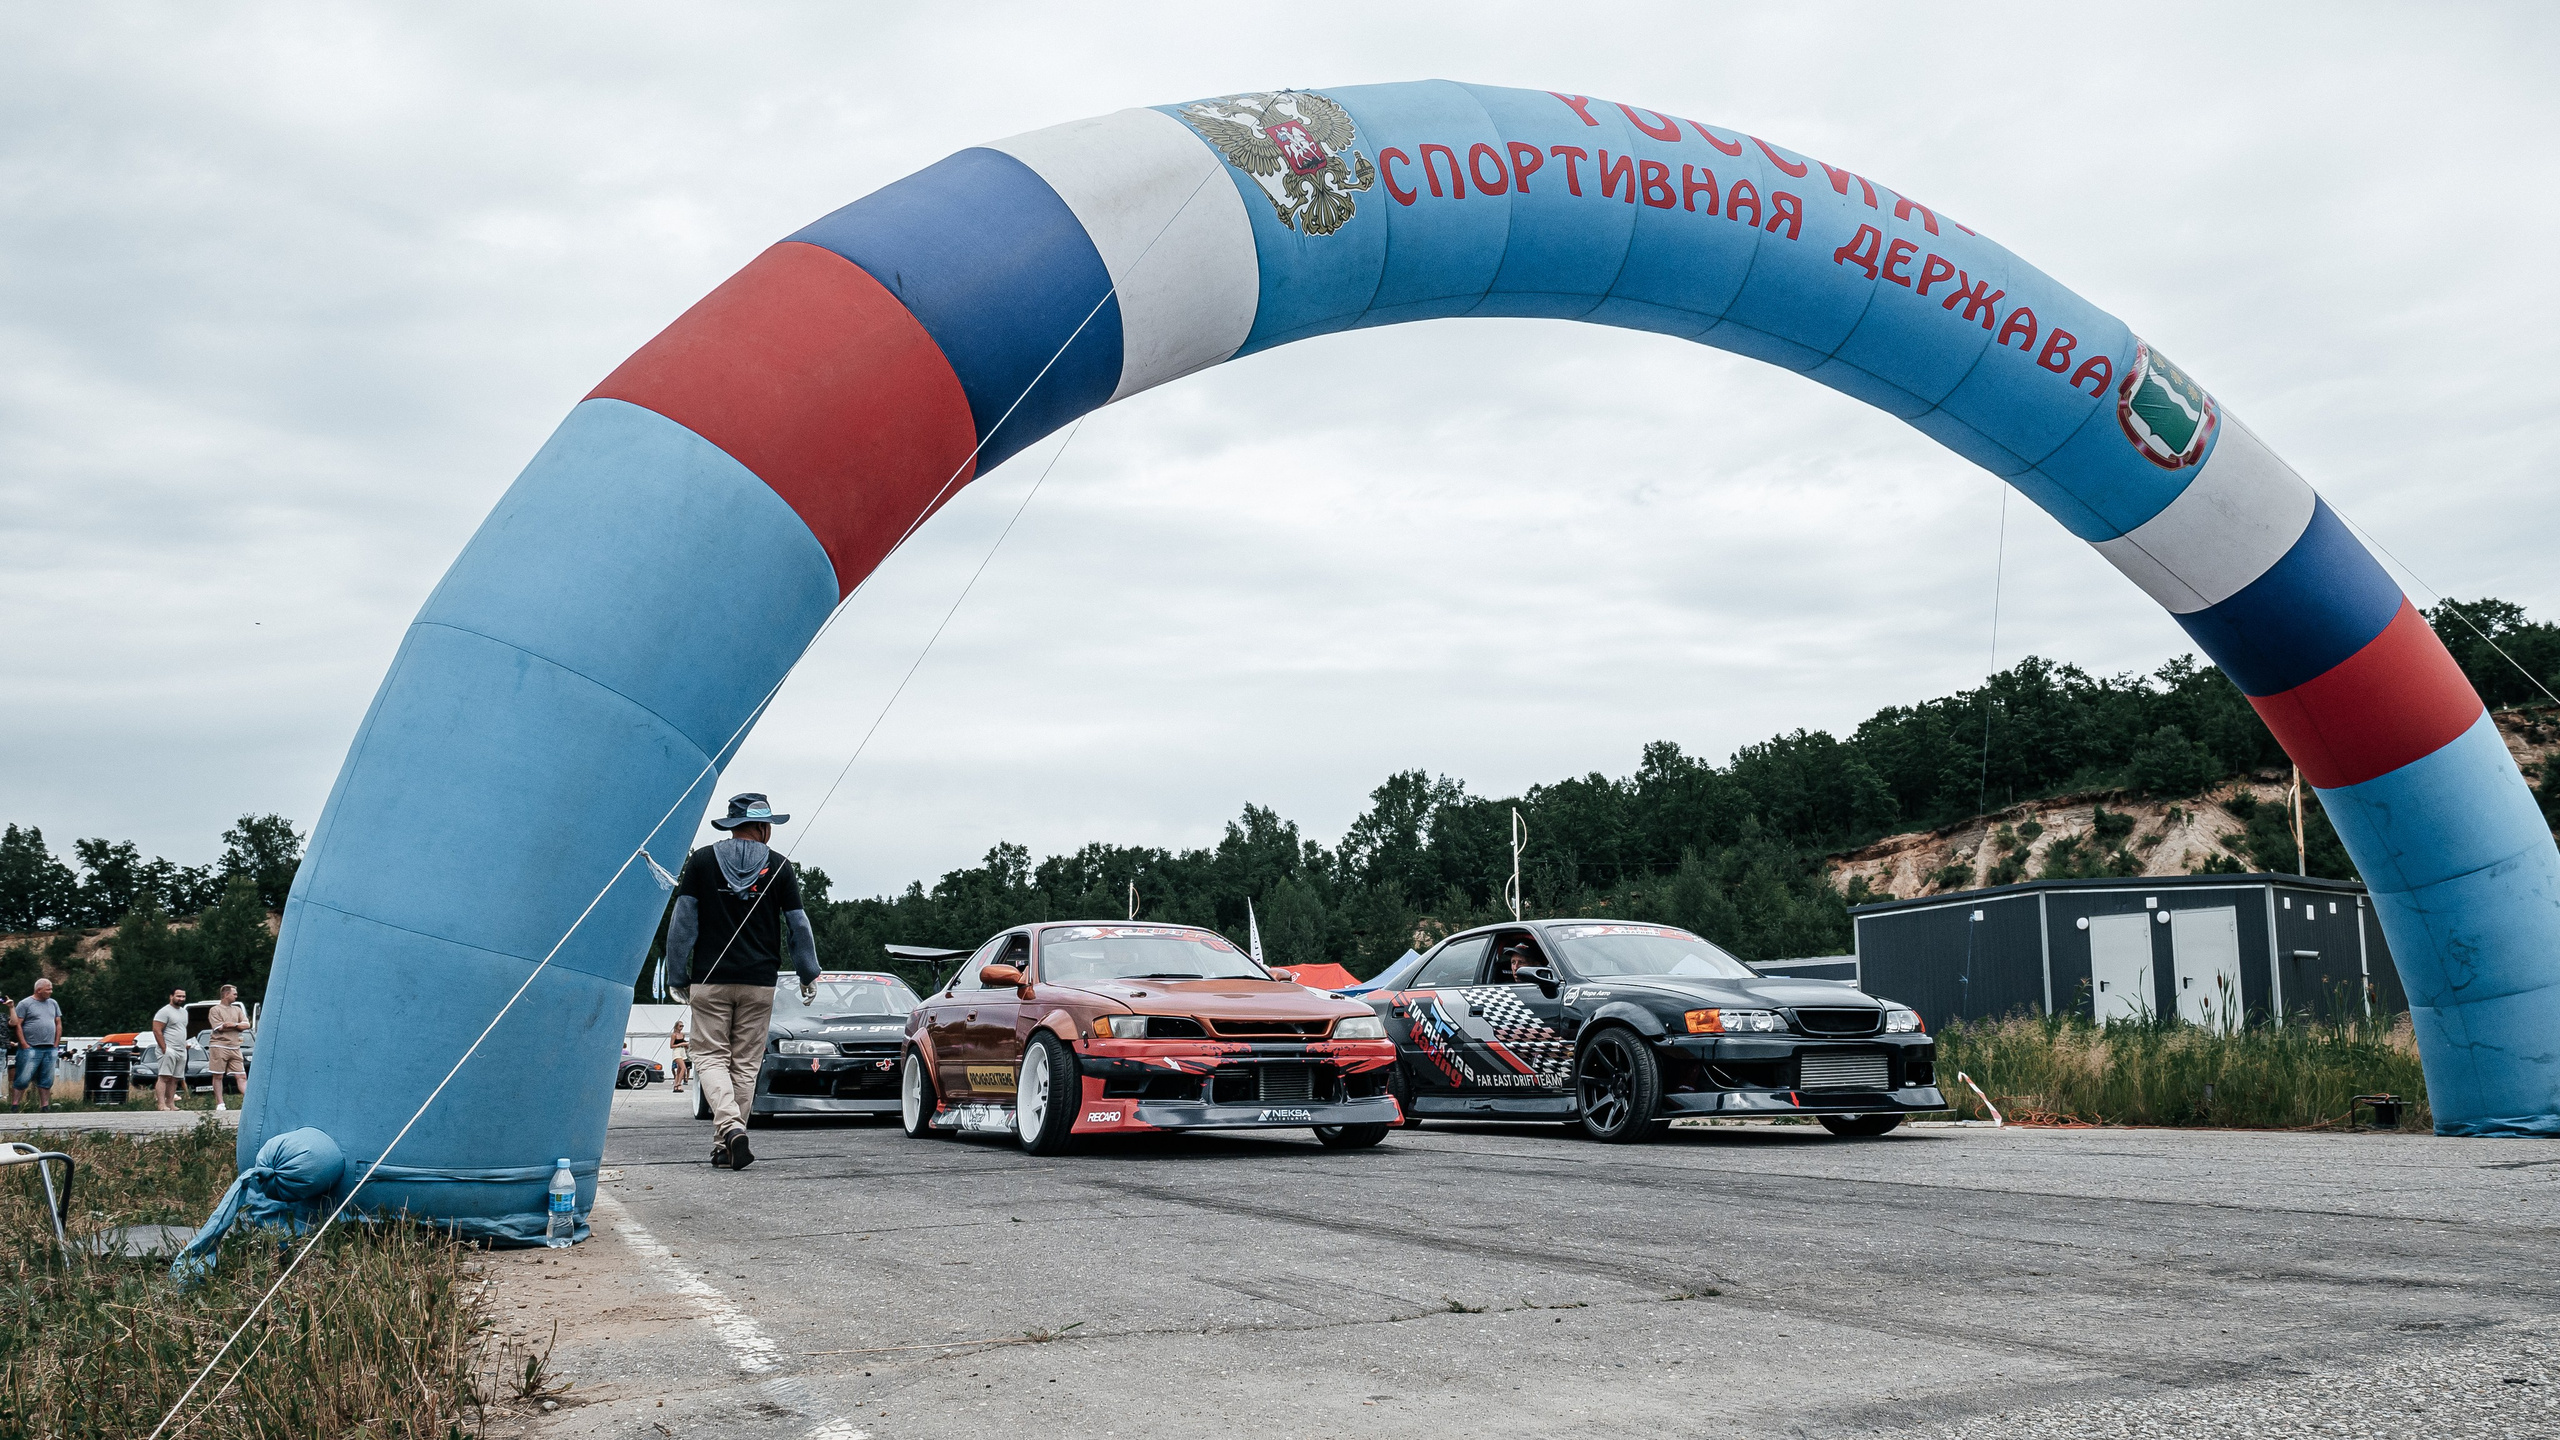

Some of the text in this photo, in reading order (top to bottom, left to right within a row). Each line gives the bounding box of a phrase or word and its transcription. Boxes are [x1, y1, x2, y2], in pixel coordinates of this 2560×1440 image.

[1379, 141, 2113, 398] СПОРТИВНАЯ ДЕРЖАВА
[1409, 1021, 1463, 1089] Racing
[100, 1076, 118, 1089] G
[1477, 1073, 1561, 1087] FAR EAST DRIFT TEAM
[1087, 1111, 1121, 1122] RECARO
[1272, 1109, 1311, 1117] NEKSA
